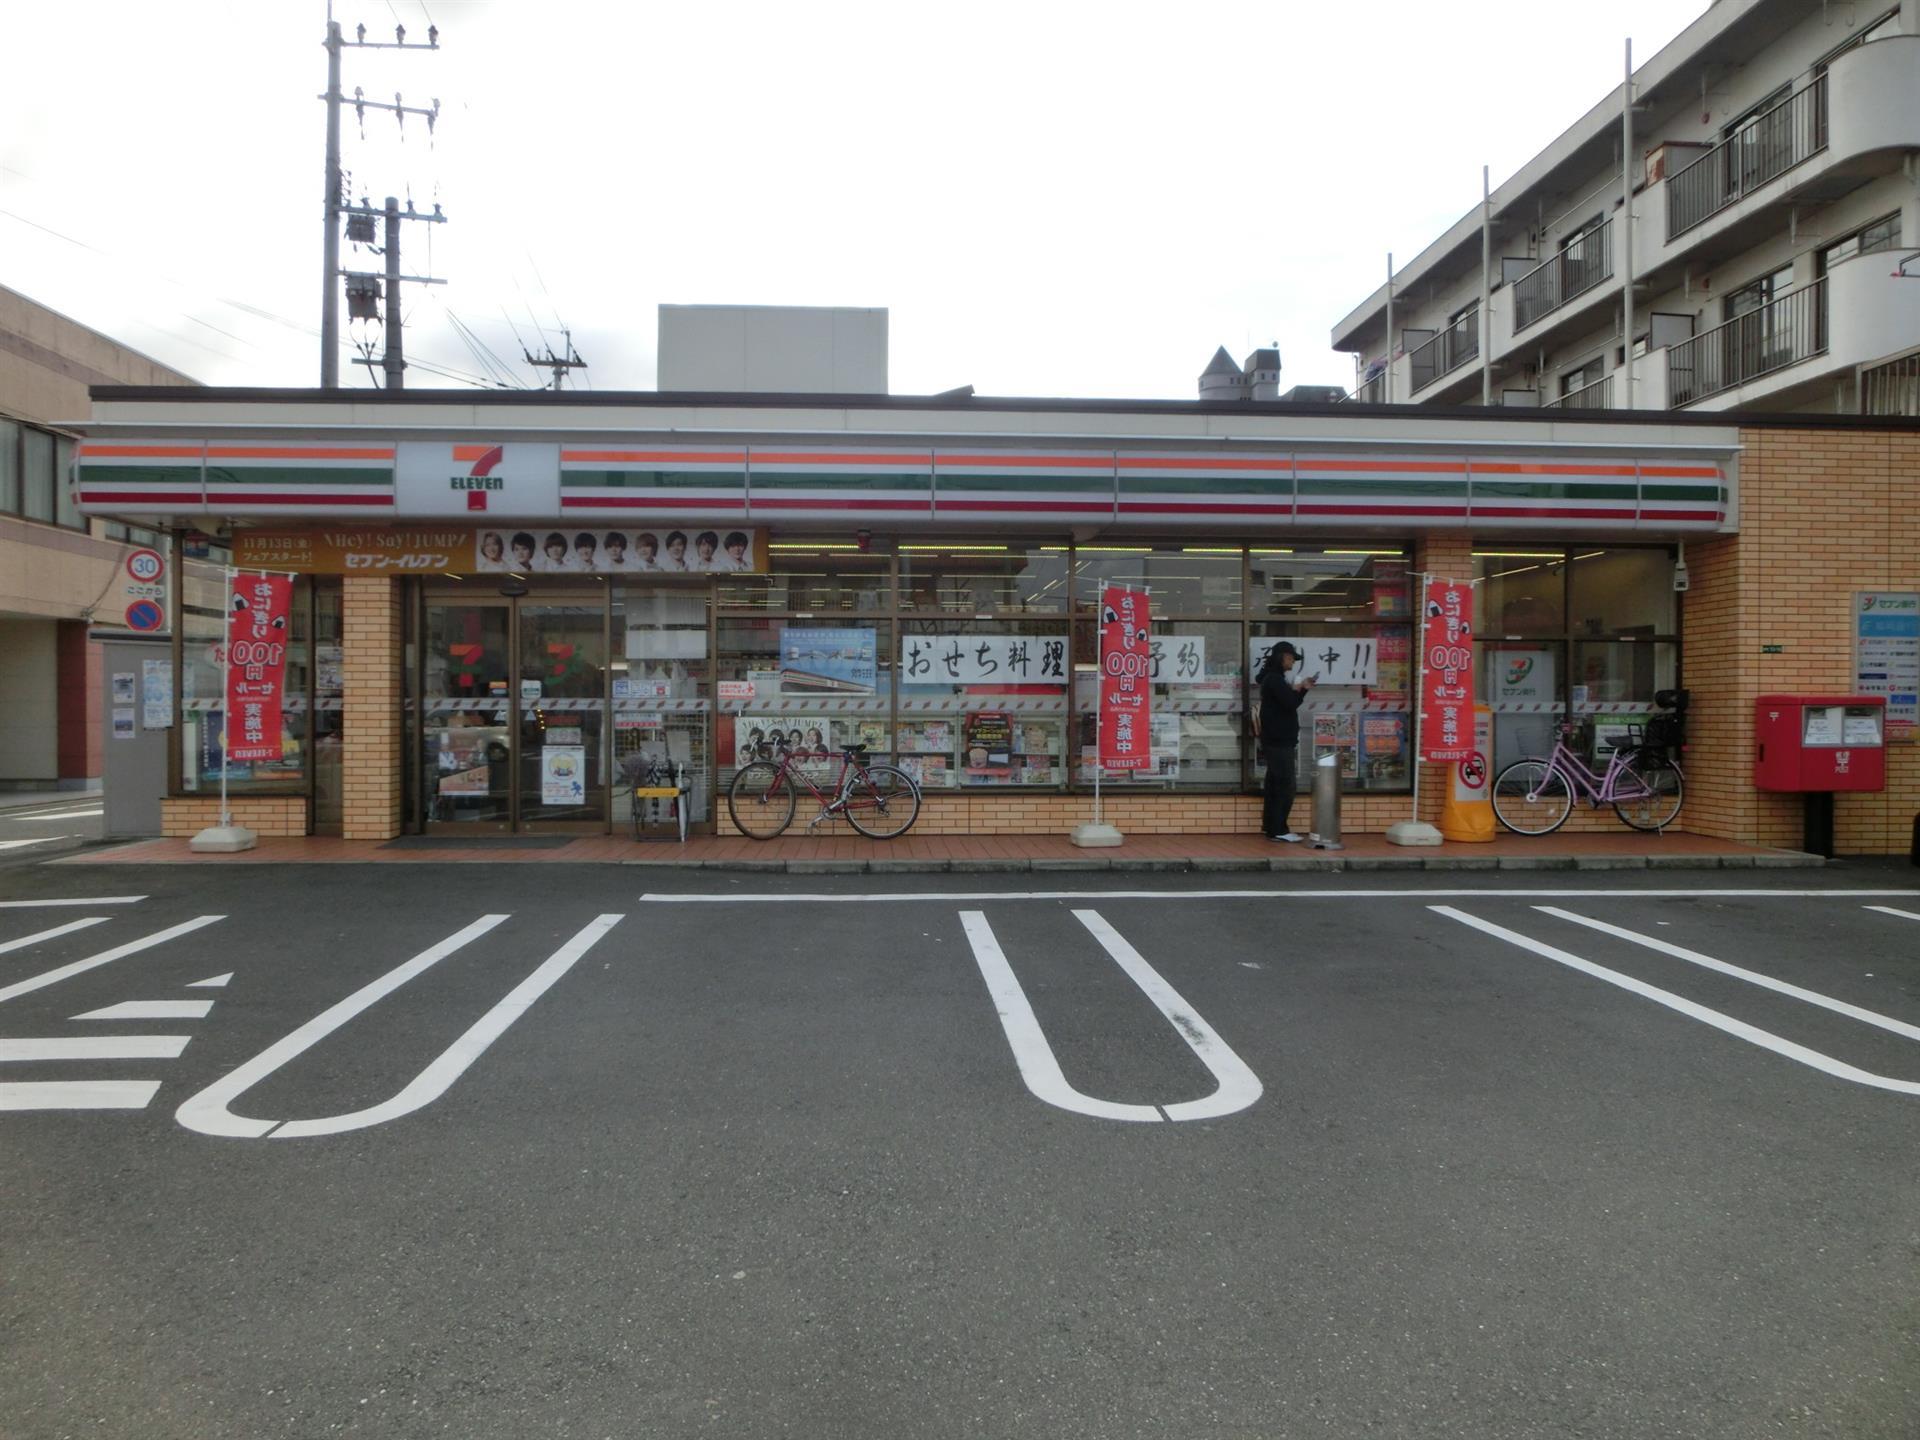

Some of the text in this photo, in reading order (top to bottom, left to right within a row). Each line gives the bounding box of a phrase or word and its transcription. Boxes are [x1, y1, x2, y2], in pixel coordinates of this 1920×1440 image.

[134, 558, 156, 573] 30
[127, 586, 162, 595] ここから
[908, 640, 1065, 677] おせち料理
